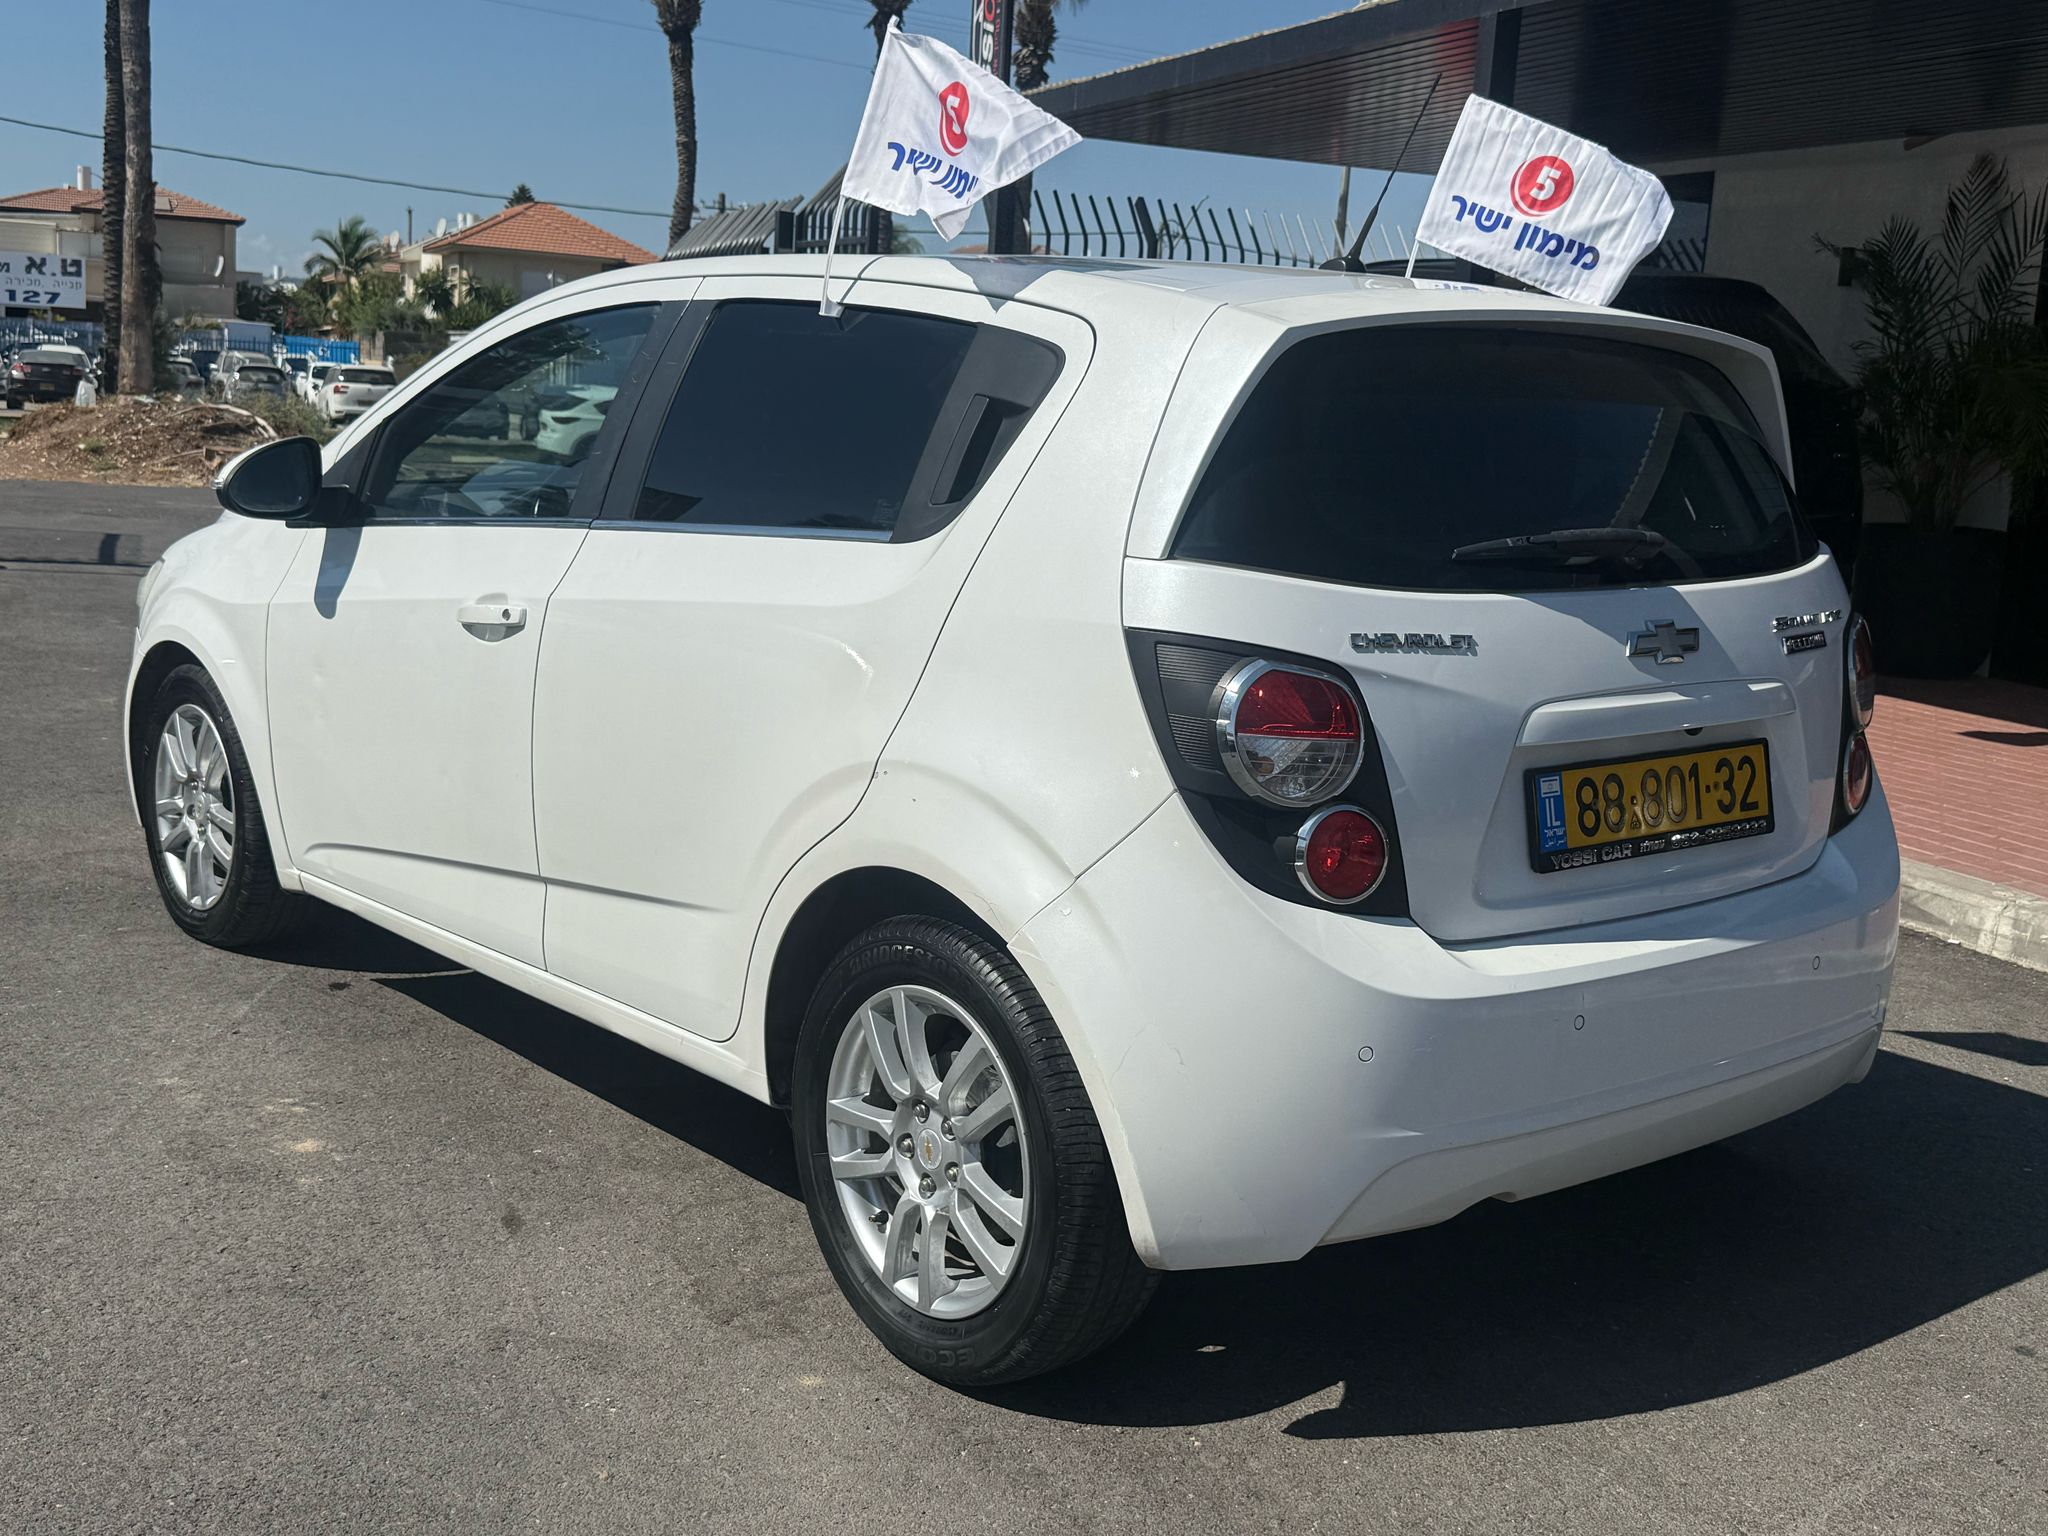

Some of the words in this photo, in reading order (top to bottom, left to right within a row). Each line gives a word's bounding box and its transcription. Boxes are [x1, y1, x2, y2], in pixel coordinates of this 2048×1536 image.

[887, 142, 942, 175] ישיר
[1529, 165, 1562, 200] 5
[1451, 195, 1512, 233] ישיר
[1513, 222, 1600, 270] מימון
[5, 289, 61, 304] 127
[1350, 633, 1473, 650] CHEVROLET
[1545, 798, 1561, 827] IL
[1602, 843, 1632, 861] CAR
